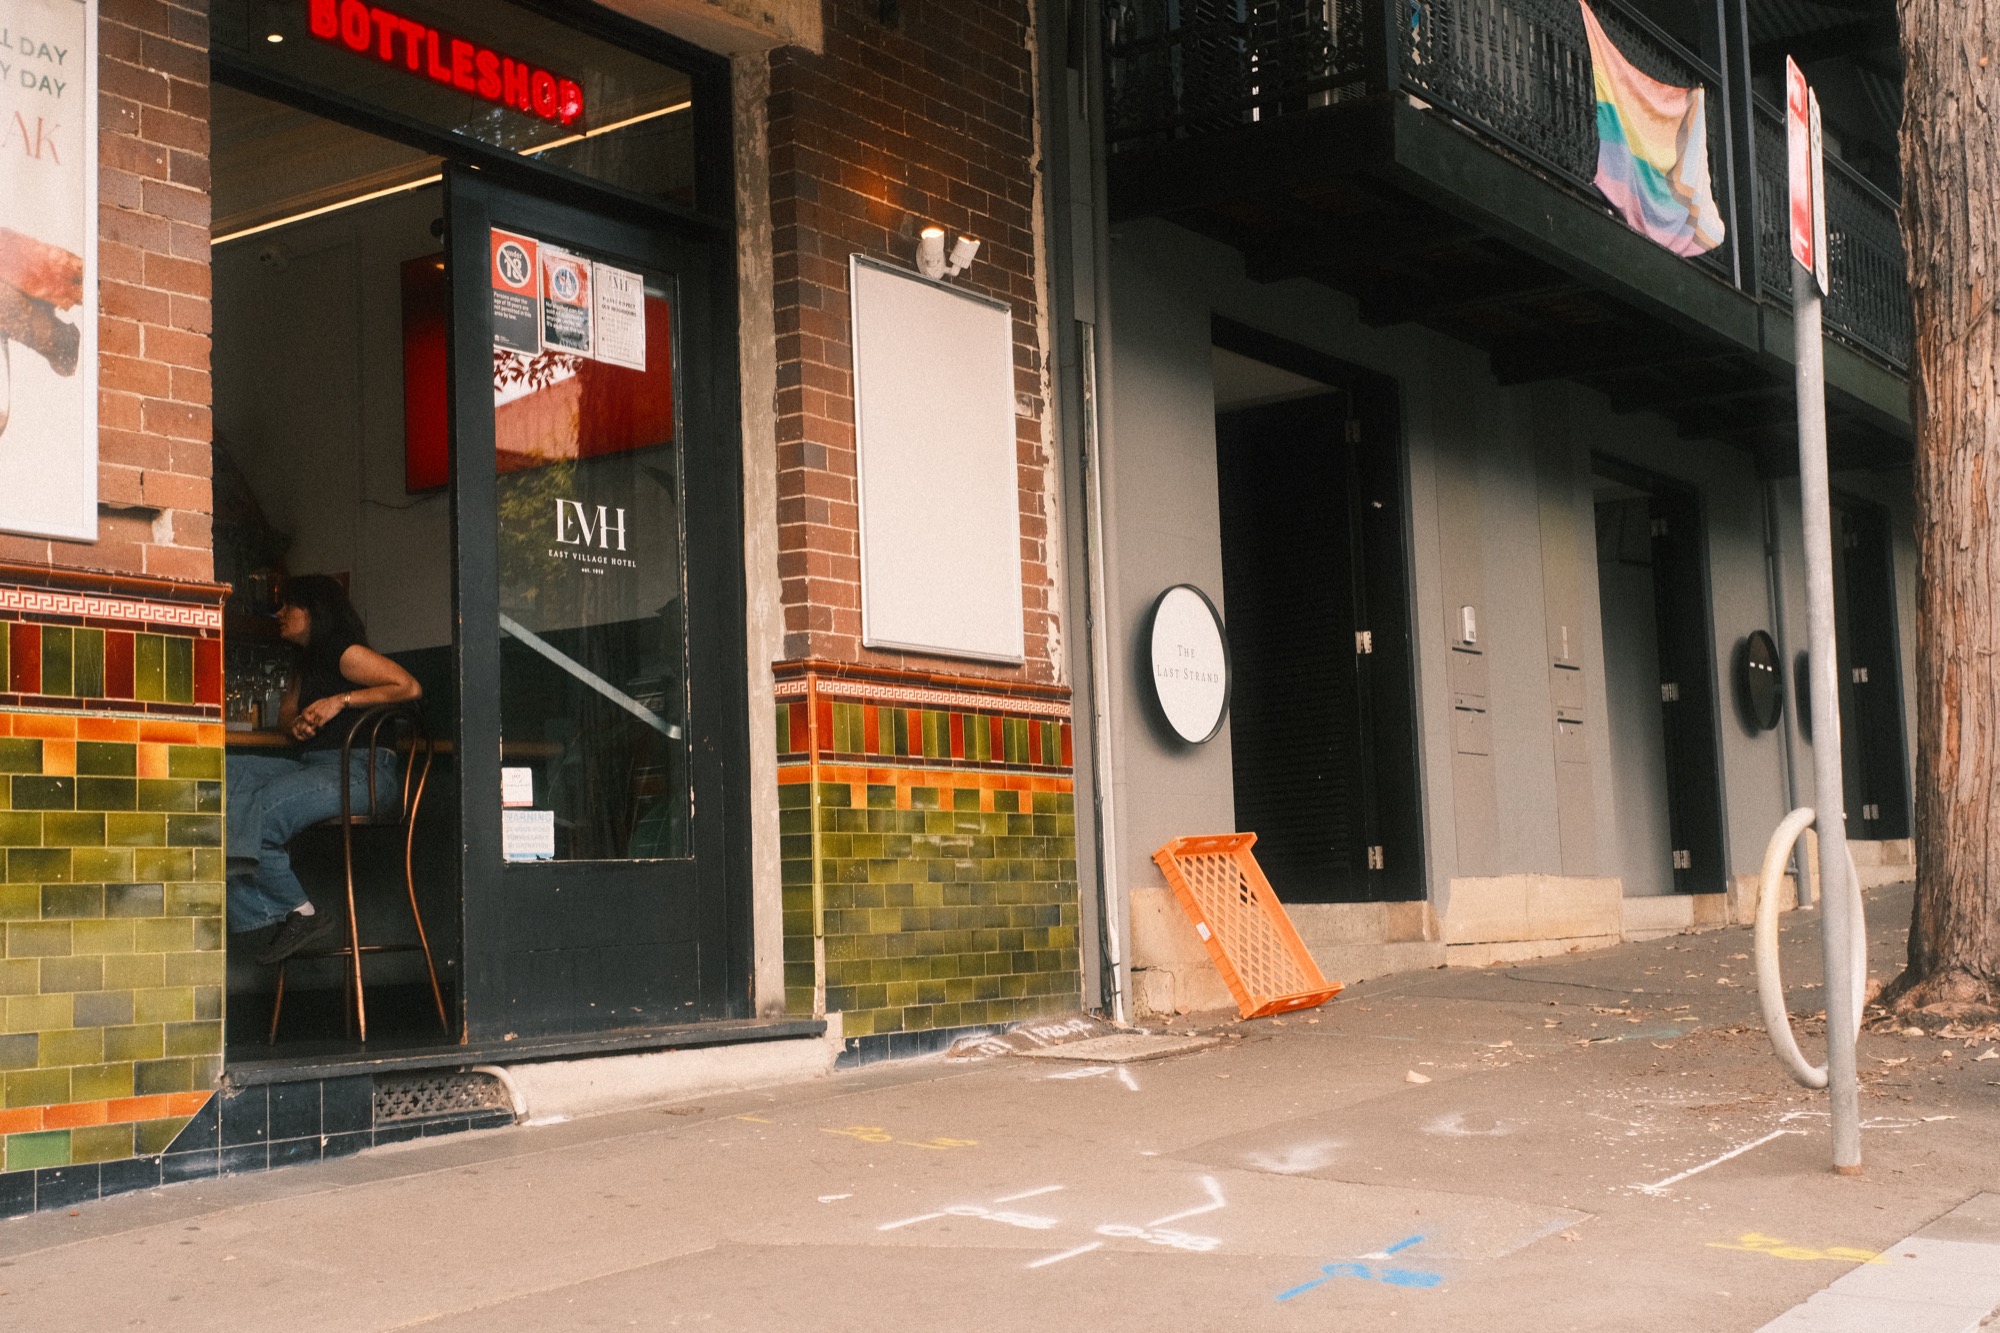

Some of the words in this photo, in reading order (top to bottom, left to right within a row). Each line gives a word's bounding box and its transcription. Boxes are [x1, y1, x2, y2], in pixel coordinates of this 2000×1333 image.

[20, 37, 68, 66] DAY
[309, 0, 583, 124] BOTTLESHOP
[20, 69, 67, 99] DAY
[504, 258, 522, 280] 18
[555, 498, 627, 551] EVH
[548, 549, 568, 559] EAST
[573, 552, 607, 564] VILLAGE
[611, 557, 636, 568] HOTEL
[1184, 668, 1218, 683] STRAND
